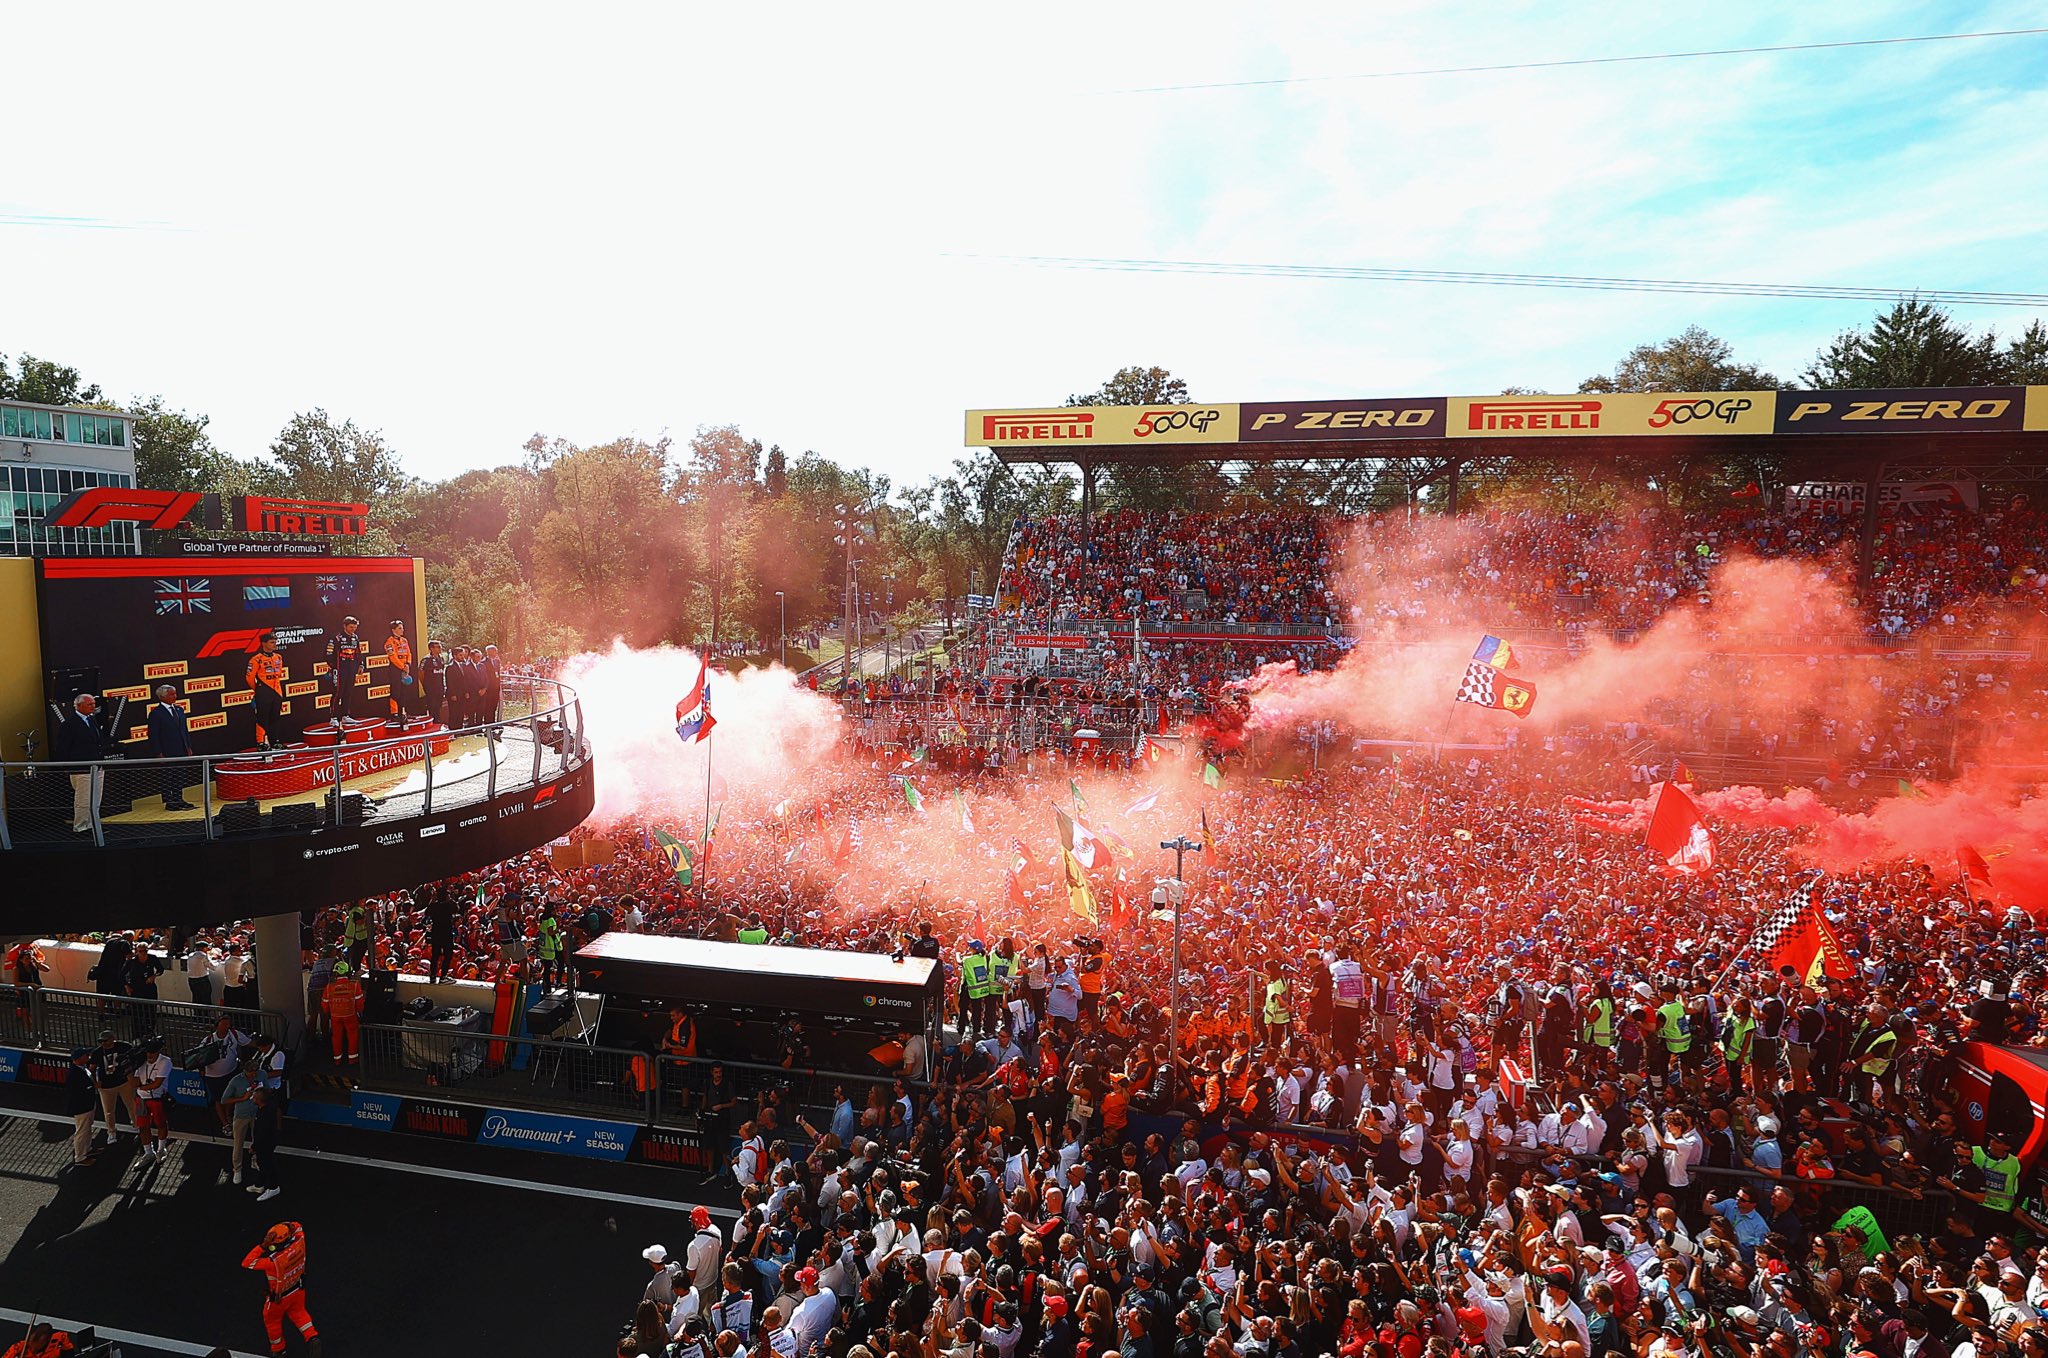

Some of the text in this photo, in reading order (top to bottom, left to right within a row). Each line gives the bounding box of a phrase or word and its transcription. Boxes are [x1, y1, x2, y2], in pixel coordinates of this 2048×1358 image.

[1468, 401, 1602, 430] PIRELLI
[1788, 400, 2012, 422] P ZERO
[1250, 408, 1436, 431] P ZERO
[982, 413, 1095, 440] PIRELLI
[1810, 484, 1902, 501] CHARES
[245, 495, 369, 535] PIRELLI
[183, 541, 215, 554] Global
[218, 543, 237, 557] Tyre
[238, 543, 271, 554] Partner
[273, 543, 282, 554] of
[284, 543, 316, 554] Formula
[275, 630, 297, 638] GRAN
[1017, 638, 1035, 646] JULES
[147, 663, 185, 677] PIRELLI
[187, 677, 223, 692] PIRELLI
[288, 683, 316, 696] PIRELLI
[190, 714, 224, 730] PIRELLI
[367, 731, 374, 741] 1
[498, 802, 525, 819] LVMH
[459, 815, 488, 828] aramco
[422, 826, 444, 836] Lenovo
[376, 832, 404, 845] QATAR
[315, 843, 360, 858] crypto.com
[878, 997, 912, 1008] chrome
[33, 1057, 71, 1069] STALLONE
[183, 1079, 201, 1088] NEW
[363, 1102, 382, 1111] NEW
[415, 1105, 460, 1118] STALLONE
[356, 1110, 391, 1122] SEASON
[482, 1115, 577, 1145] Paramount+
[594, 1130, 616, 1141] NEW
[586, 1138, 625, 1151] SEASON
